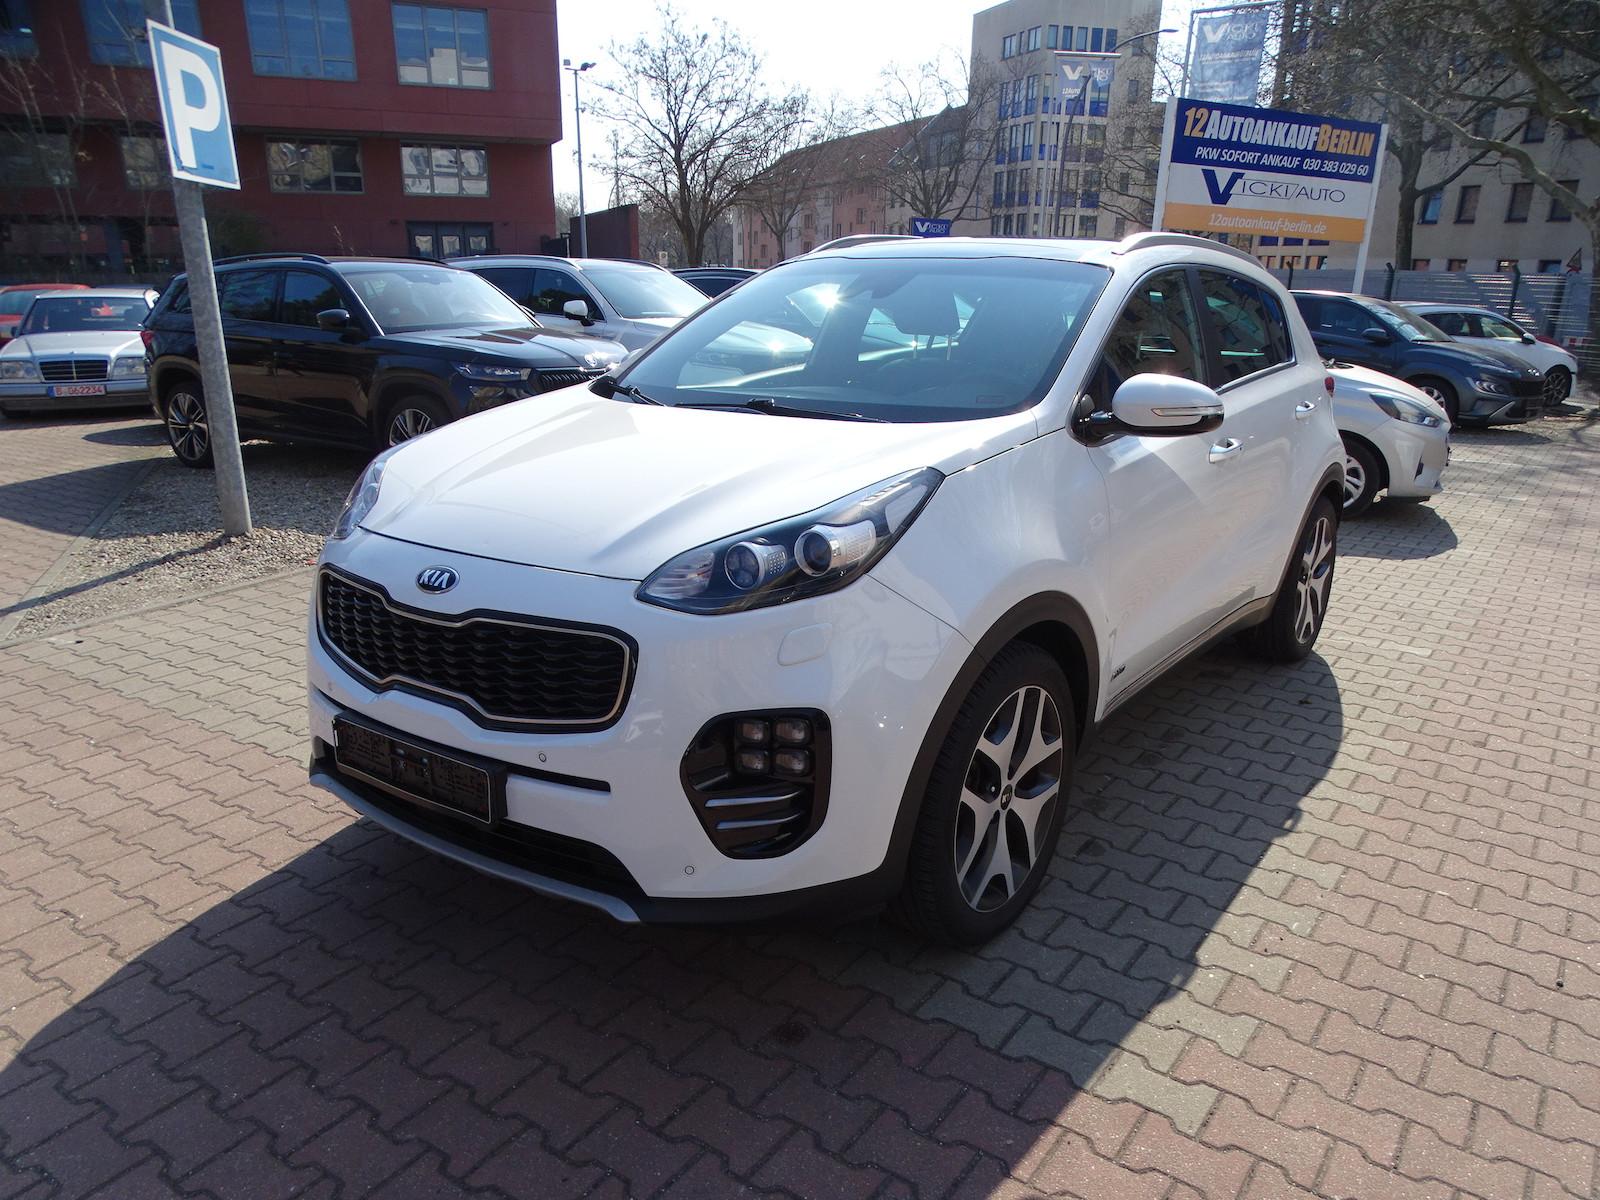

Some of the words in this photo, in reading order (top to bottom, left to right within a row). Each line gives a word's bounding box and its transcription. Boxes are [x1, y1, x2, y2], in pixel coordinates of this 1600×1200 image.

[160, 40, 221, 169] P
[1195, 146, 1220, 160] PKW
[1220, 150, 1261, 165] SOFORT
[1260, 155, 1301, 169] ANKAUF
[1303, 158, 1321, 171] 030
[1321, 160, 1339, 173] 383
[1340, 162, 1358, 175] 029
[1357, 164, 1370, 176] 60
[1208, 214, 1326, 234] 12autoankauf-berlin.de
[419, 569, 450, 588] KIA
